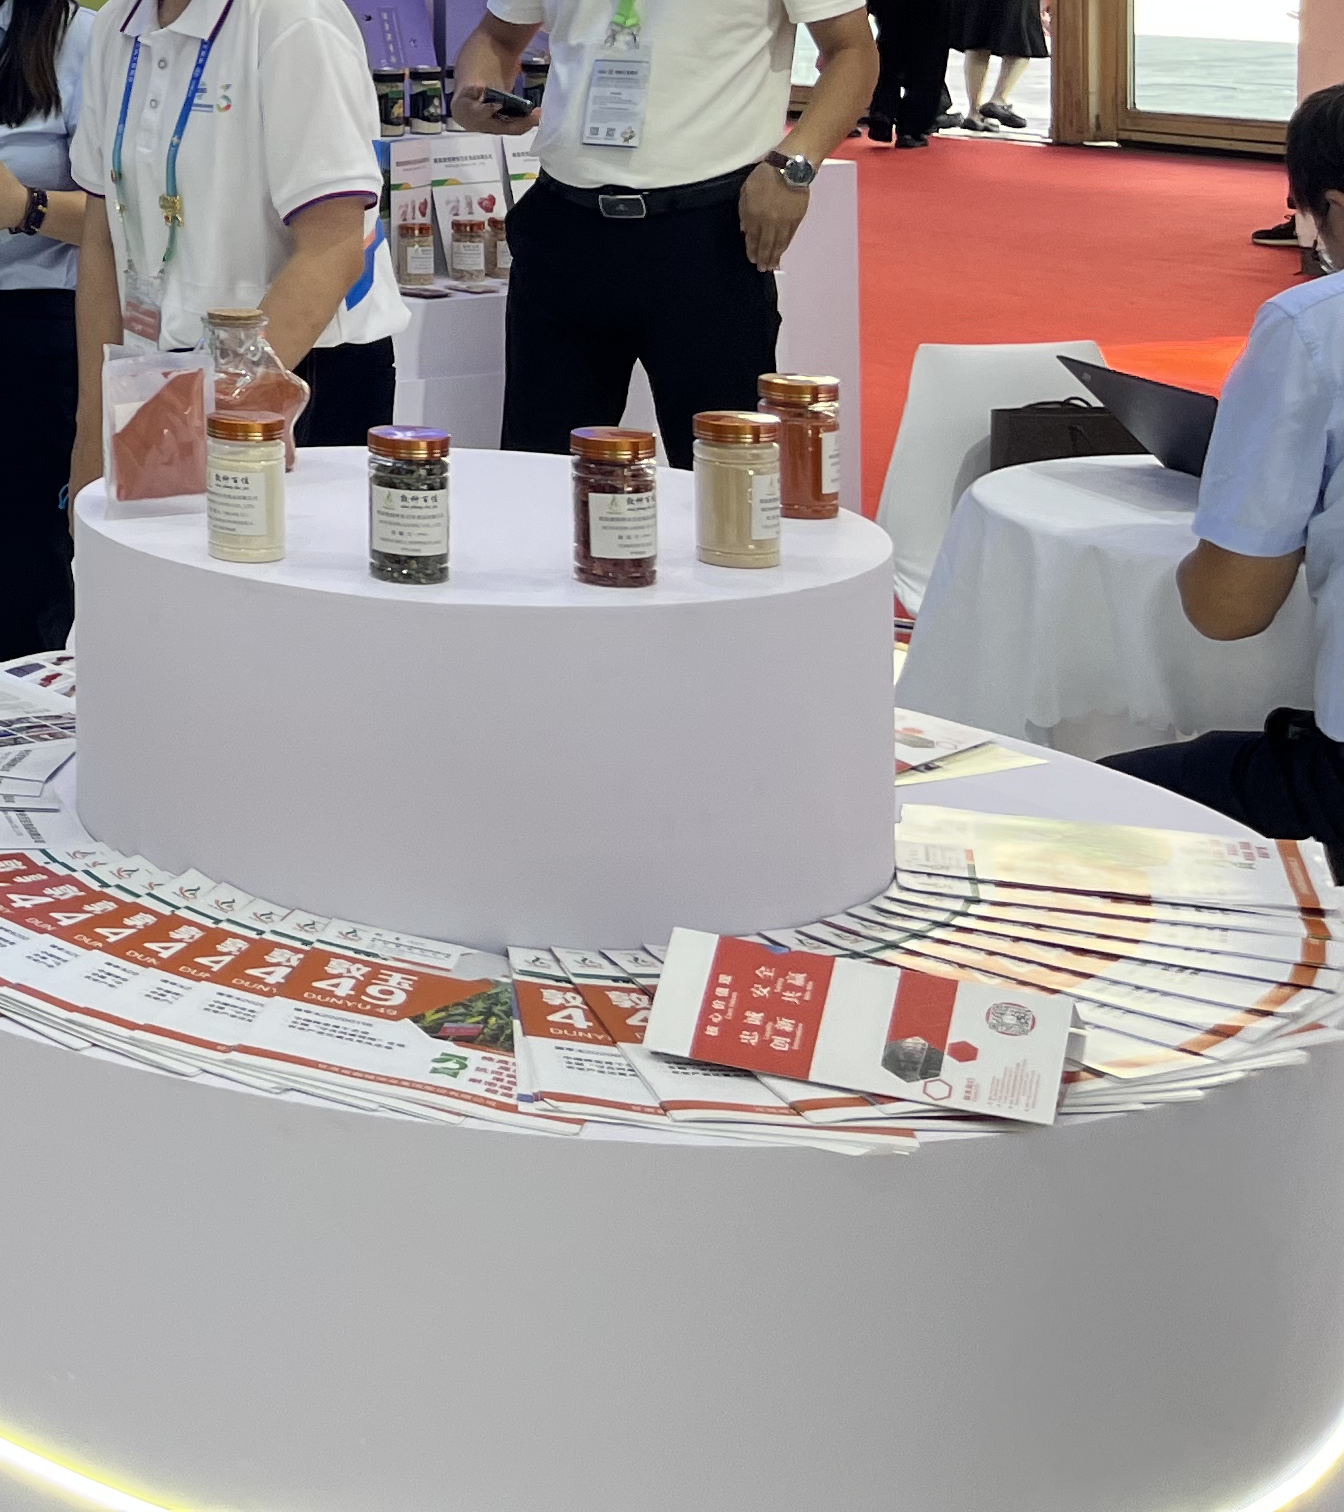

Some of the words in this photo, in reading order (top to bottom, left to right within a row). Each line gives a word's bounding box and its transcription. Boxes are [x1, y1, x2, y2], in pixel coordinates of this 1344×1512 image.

[312, 977, 407, 1006] 49
[750, 965, 777, 998] 安全
[769, 1016, 796, 1051] 创新
